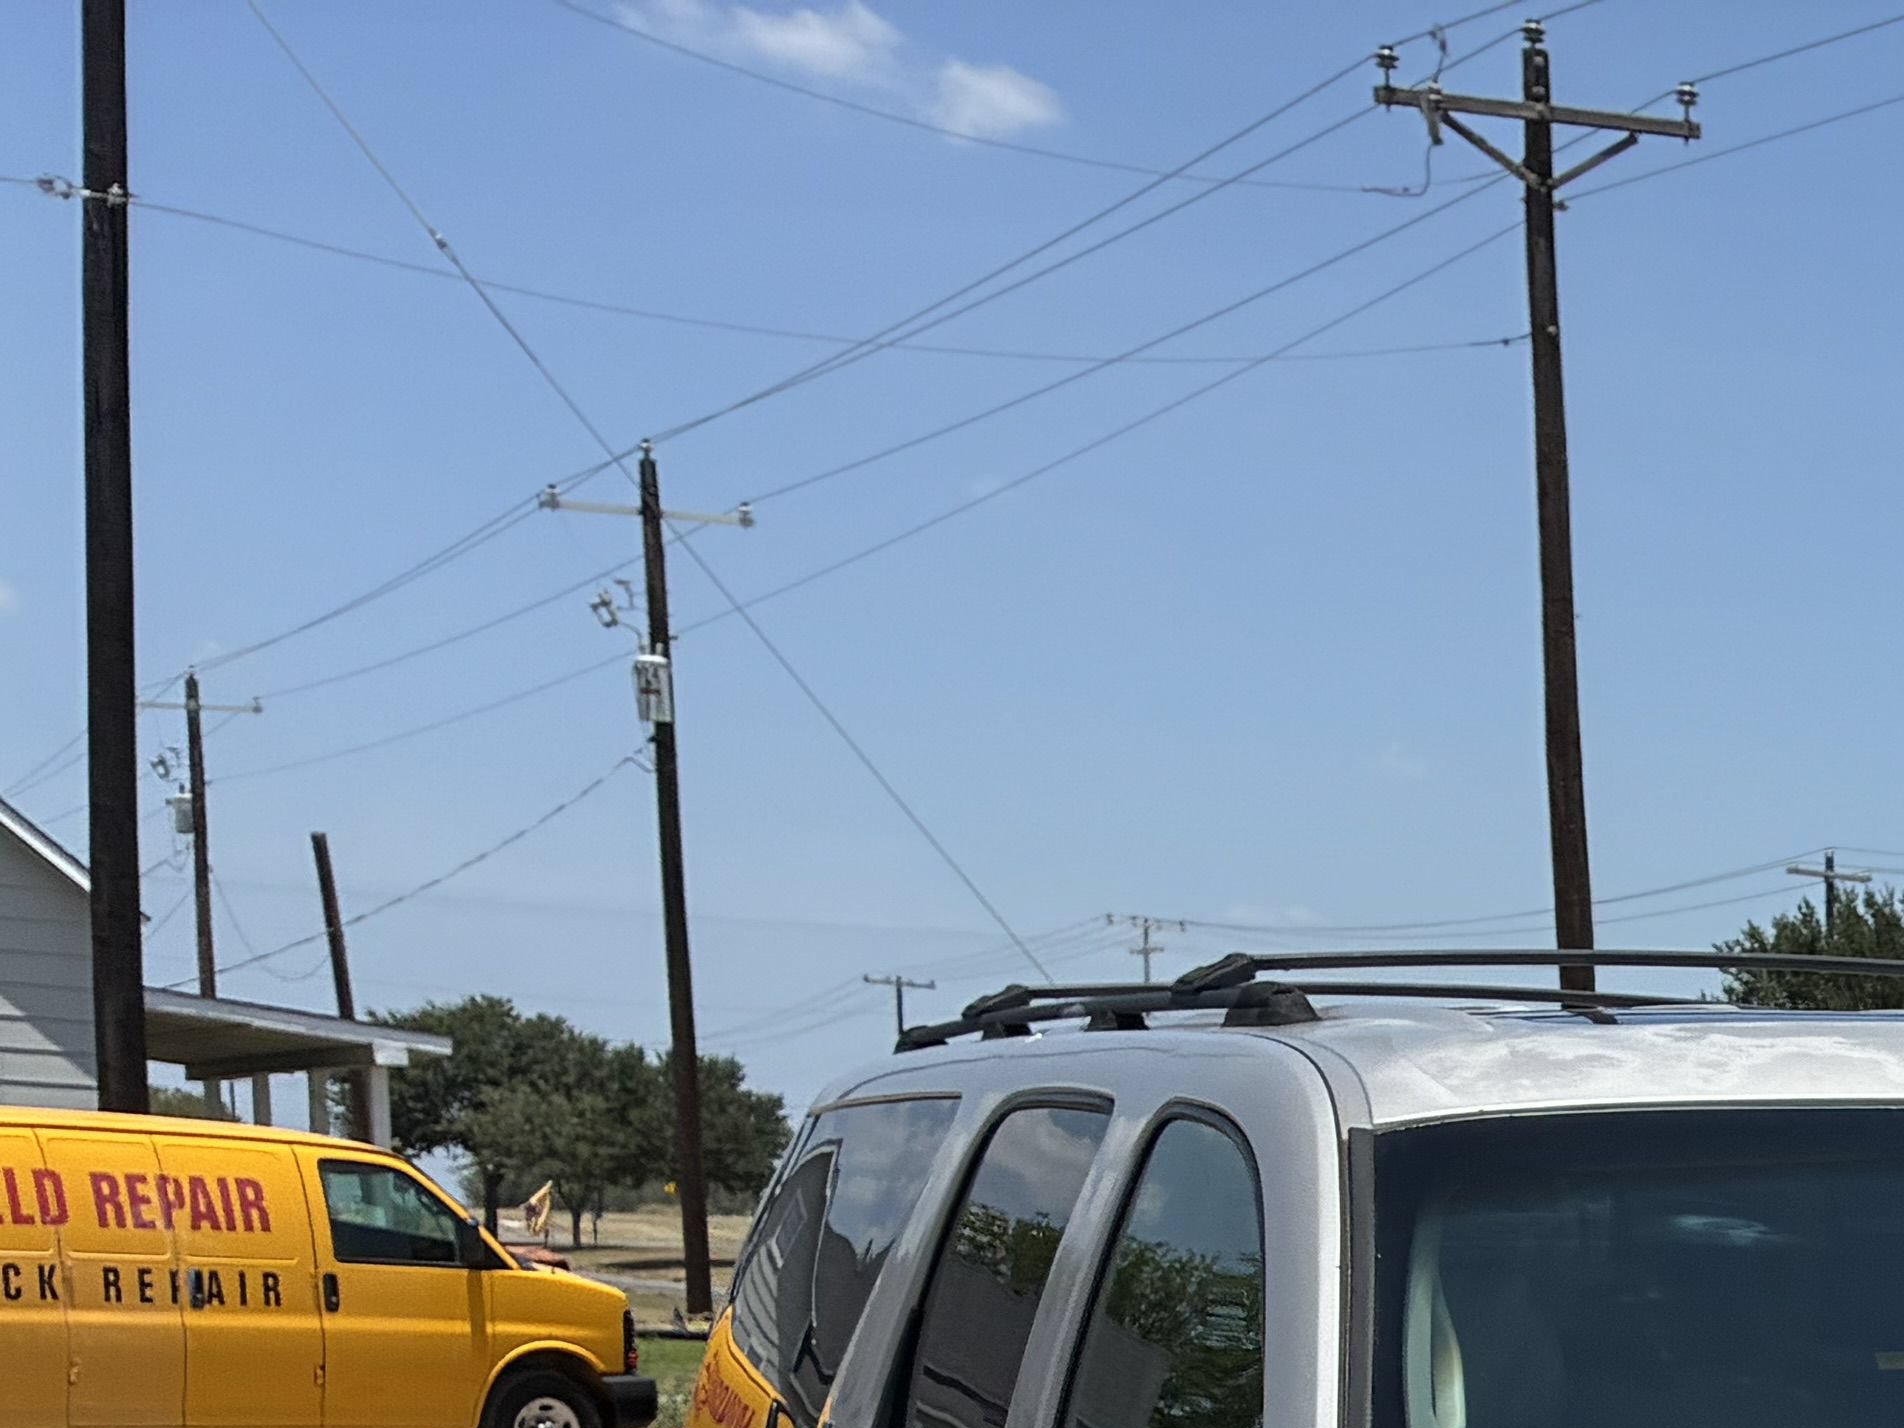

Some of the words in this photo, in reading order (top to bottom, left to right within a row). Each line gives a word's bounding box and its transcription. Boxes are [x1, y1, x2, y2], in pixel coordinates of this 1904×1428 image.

[0, 1167, 69, 1225] LD
[89, 1171, 271, 1232] REPAIR
[2, 1262, 59, 1301] CK
